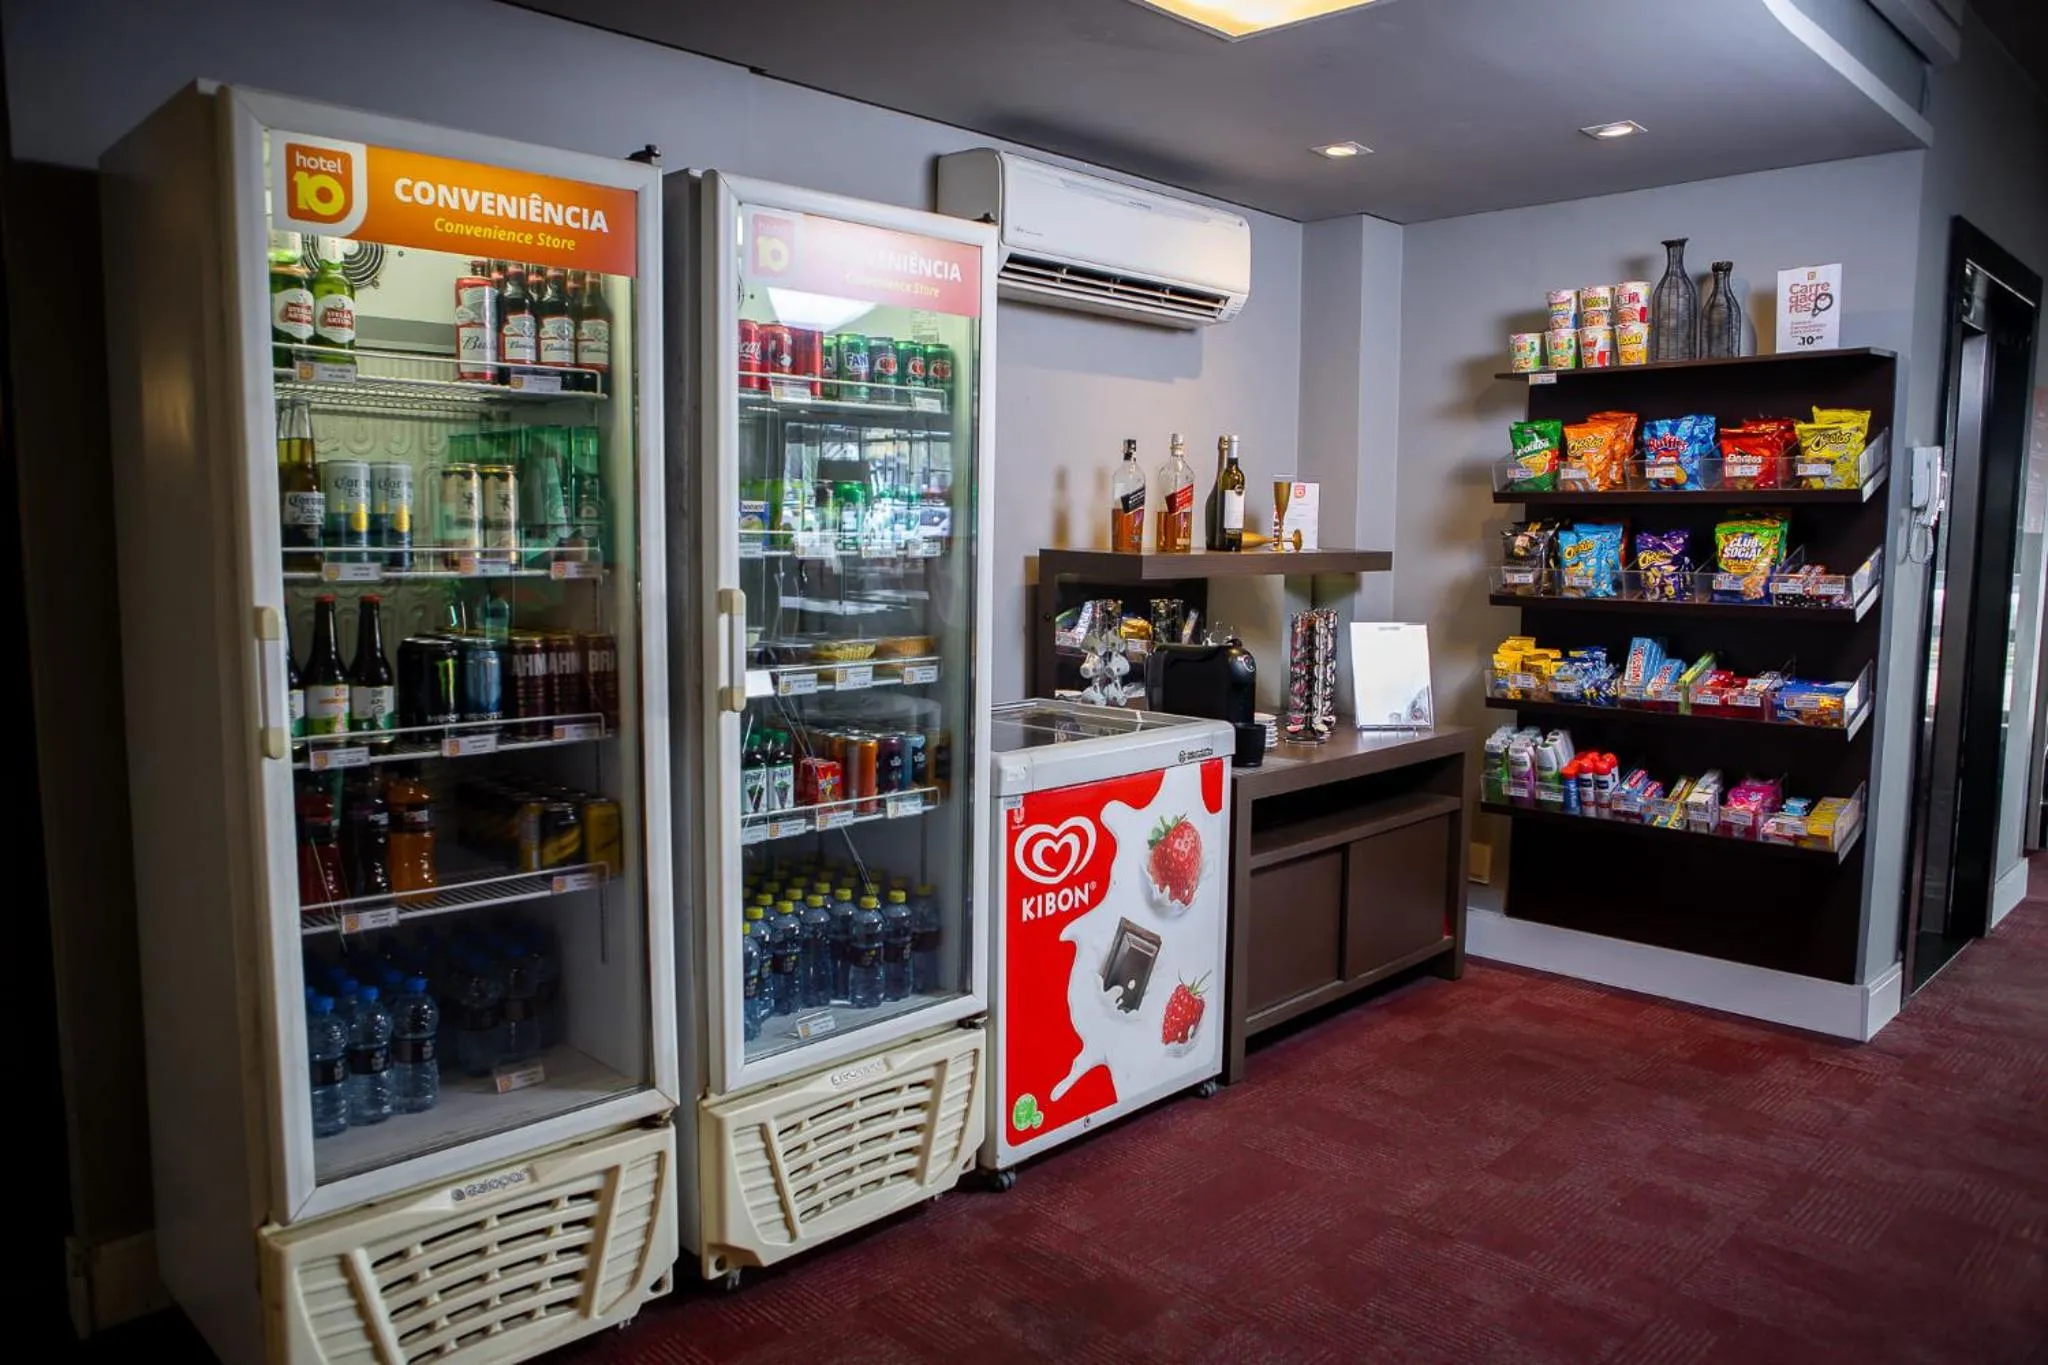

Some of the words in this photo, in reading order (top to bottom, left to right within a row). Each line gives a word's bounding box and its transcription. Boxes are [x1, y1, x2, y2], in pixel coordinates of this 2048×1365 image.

[295, 150, 342, 174] hotel
[293, 171, 344, 216] 10
[394, 177, 609, 233] CONVENIÊNCIA
[433, 216, 533, 245] Convenience
[536, 232, 577, 251] Store
[1810, 431, 1852, 451] Cheetos
[1723, 547, 1763, 560] SOCIAL
[1730, 536, 1758, 548] CLUB
